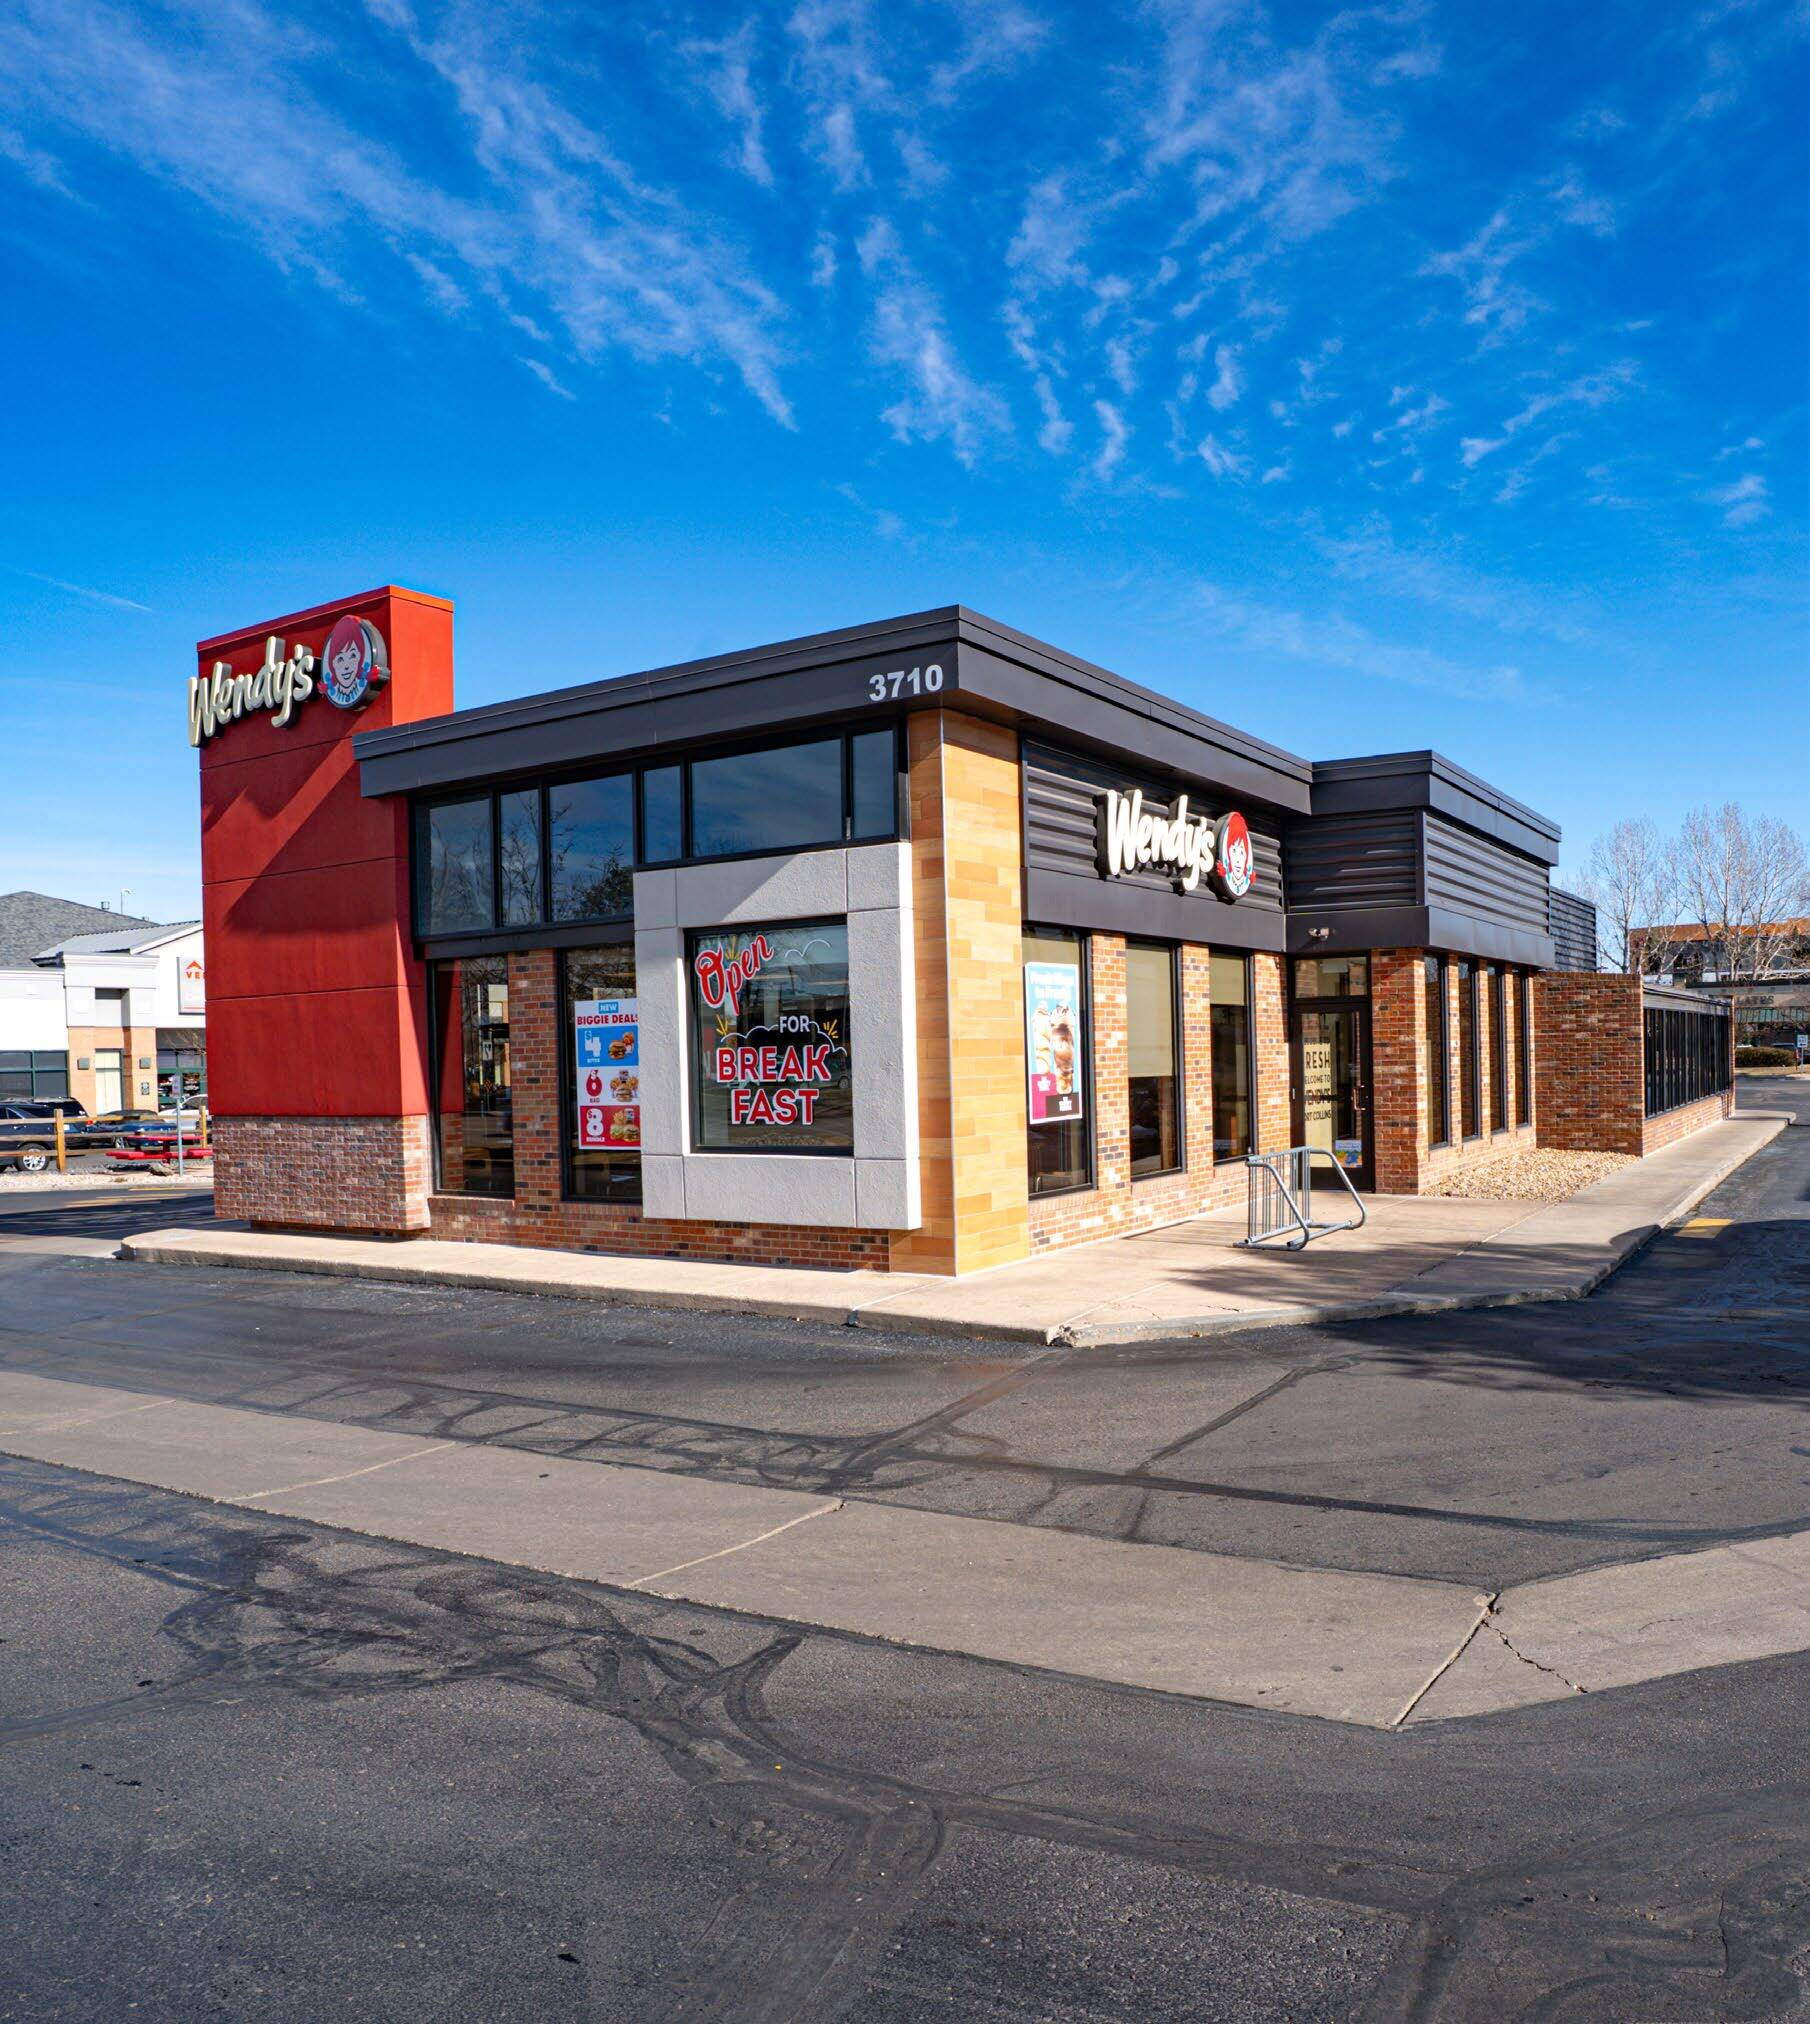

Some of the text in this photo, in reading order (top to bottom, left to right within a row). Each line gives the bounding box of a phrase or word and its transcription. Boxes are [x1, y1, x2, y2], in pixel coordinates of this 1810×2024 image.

[188, 635, 314, 747] Wendy's
[868, 664, 943, 702] 3710
[1107, 788, 1215, 891] Wendy's
[694, 934, 775, 1016] Open
[577, 1015, 609, 1025] BIGGIE
[600, 1003, 618, 1012] NEW
[779, 1014, 810, 1033] FOR
[716, 1043, 832, 1083] BREAK
[1306, 1051, 1330, 1069] RESH
[731, 1087, 819, 1126] FAST
